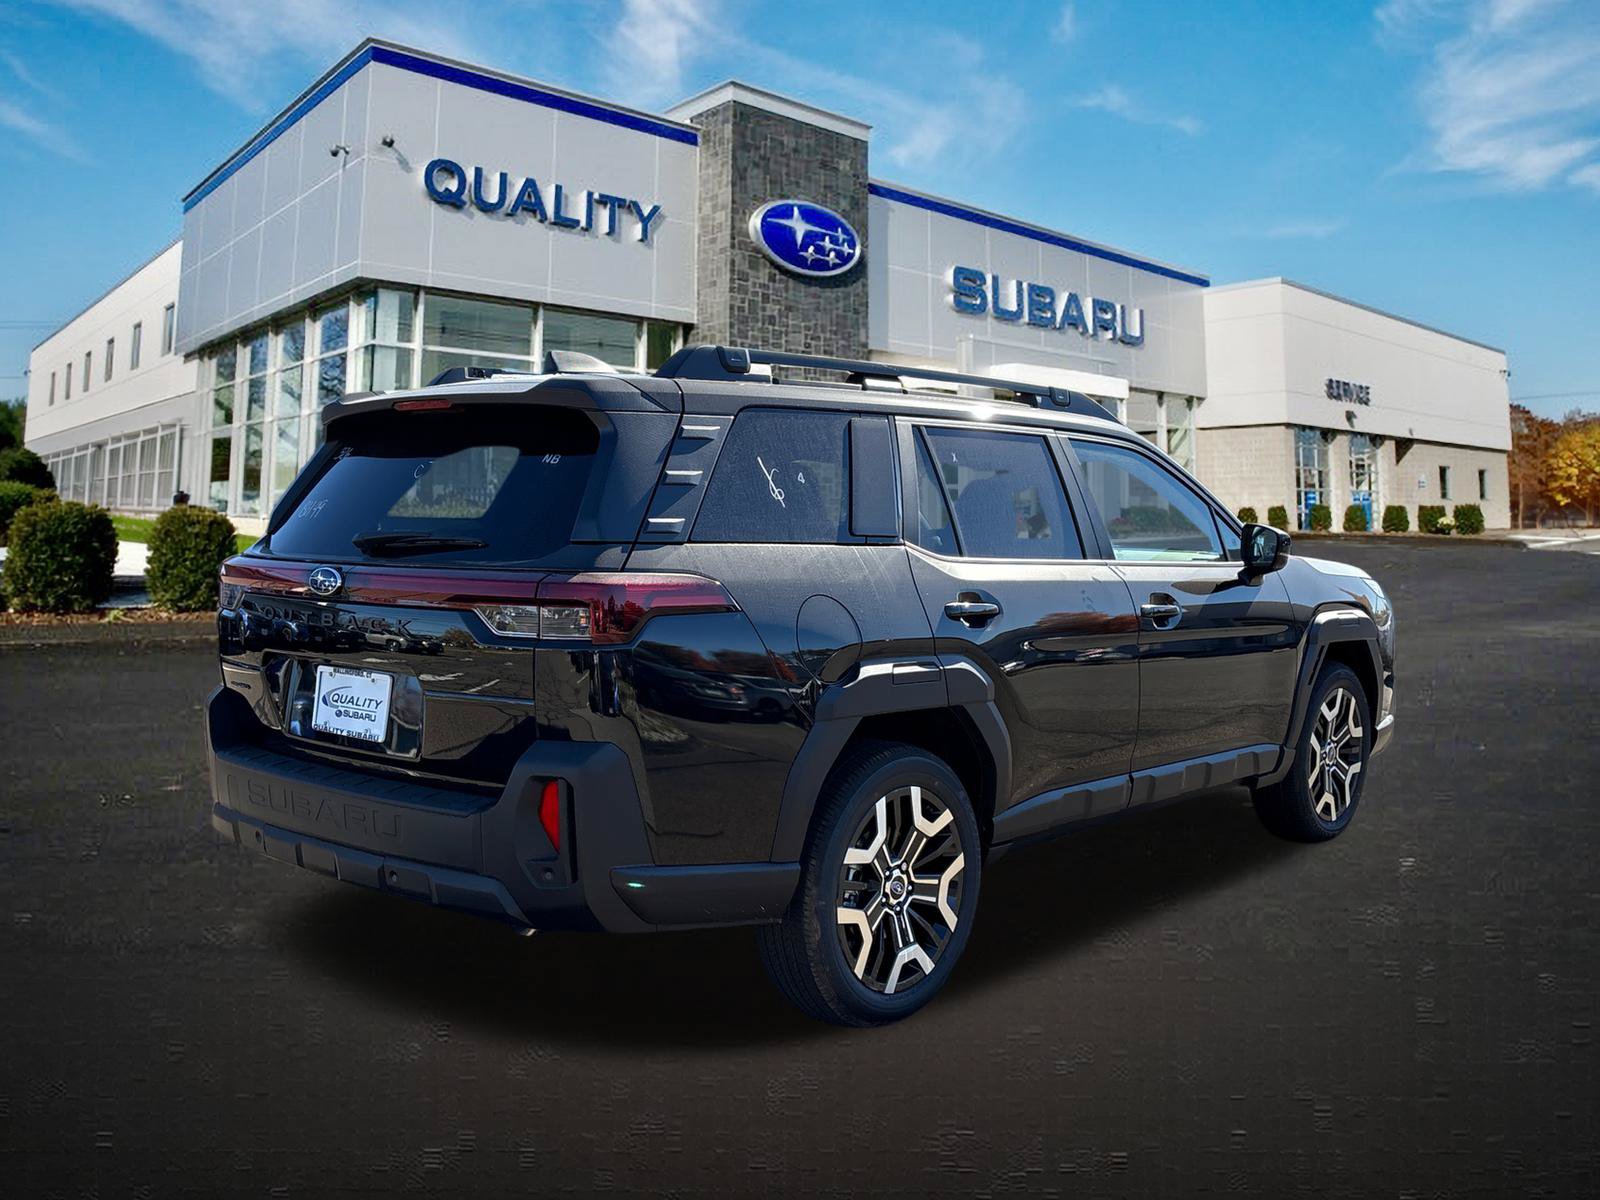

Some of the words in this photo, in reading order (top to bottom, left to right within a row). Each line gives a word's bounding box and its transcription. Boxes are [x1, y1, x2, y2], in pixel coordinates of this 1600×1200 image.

[424, 158, 662, 243] QUALITY
[952, 265, 1144, 346] SUBARU
[263, 606, 413, 635] OUTBACK
[331, 693, 383, 710] QUALITY
[342, 709, 377, 723] SUBARU
[314, 723, 344, 734] QUALITY
[346, 730, 380, 742] SUBARU
[247, 780, 401, 838] SUBARU
